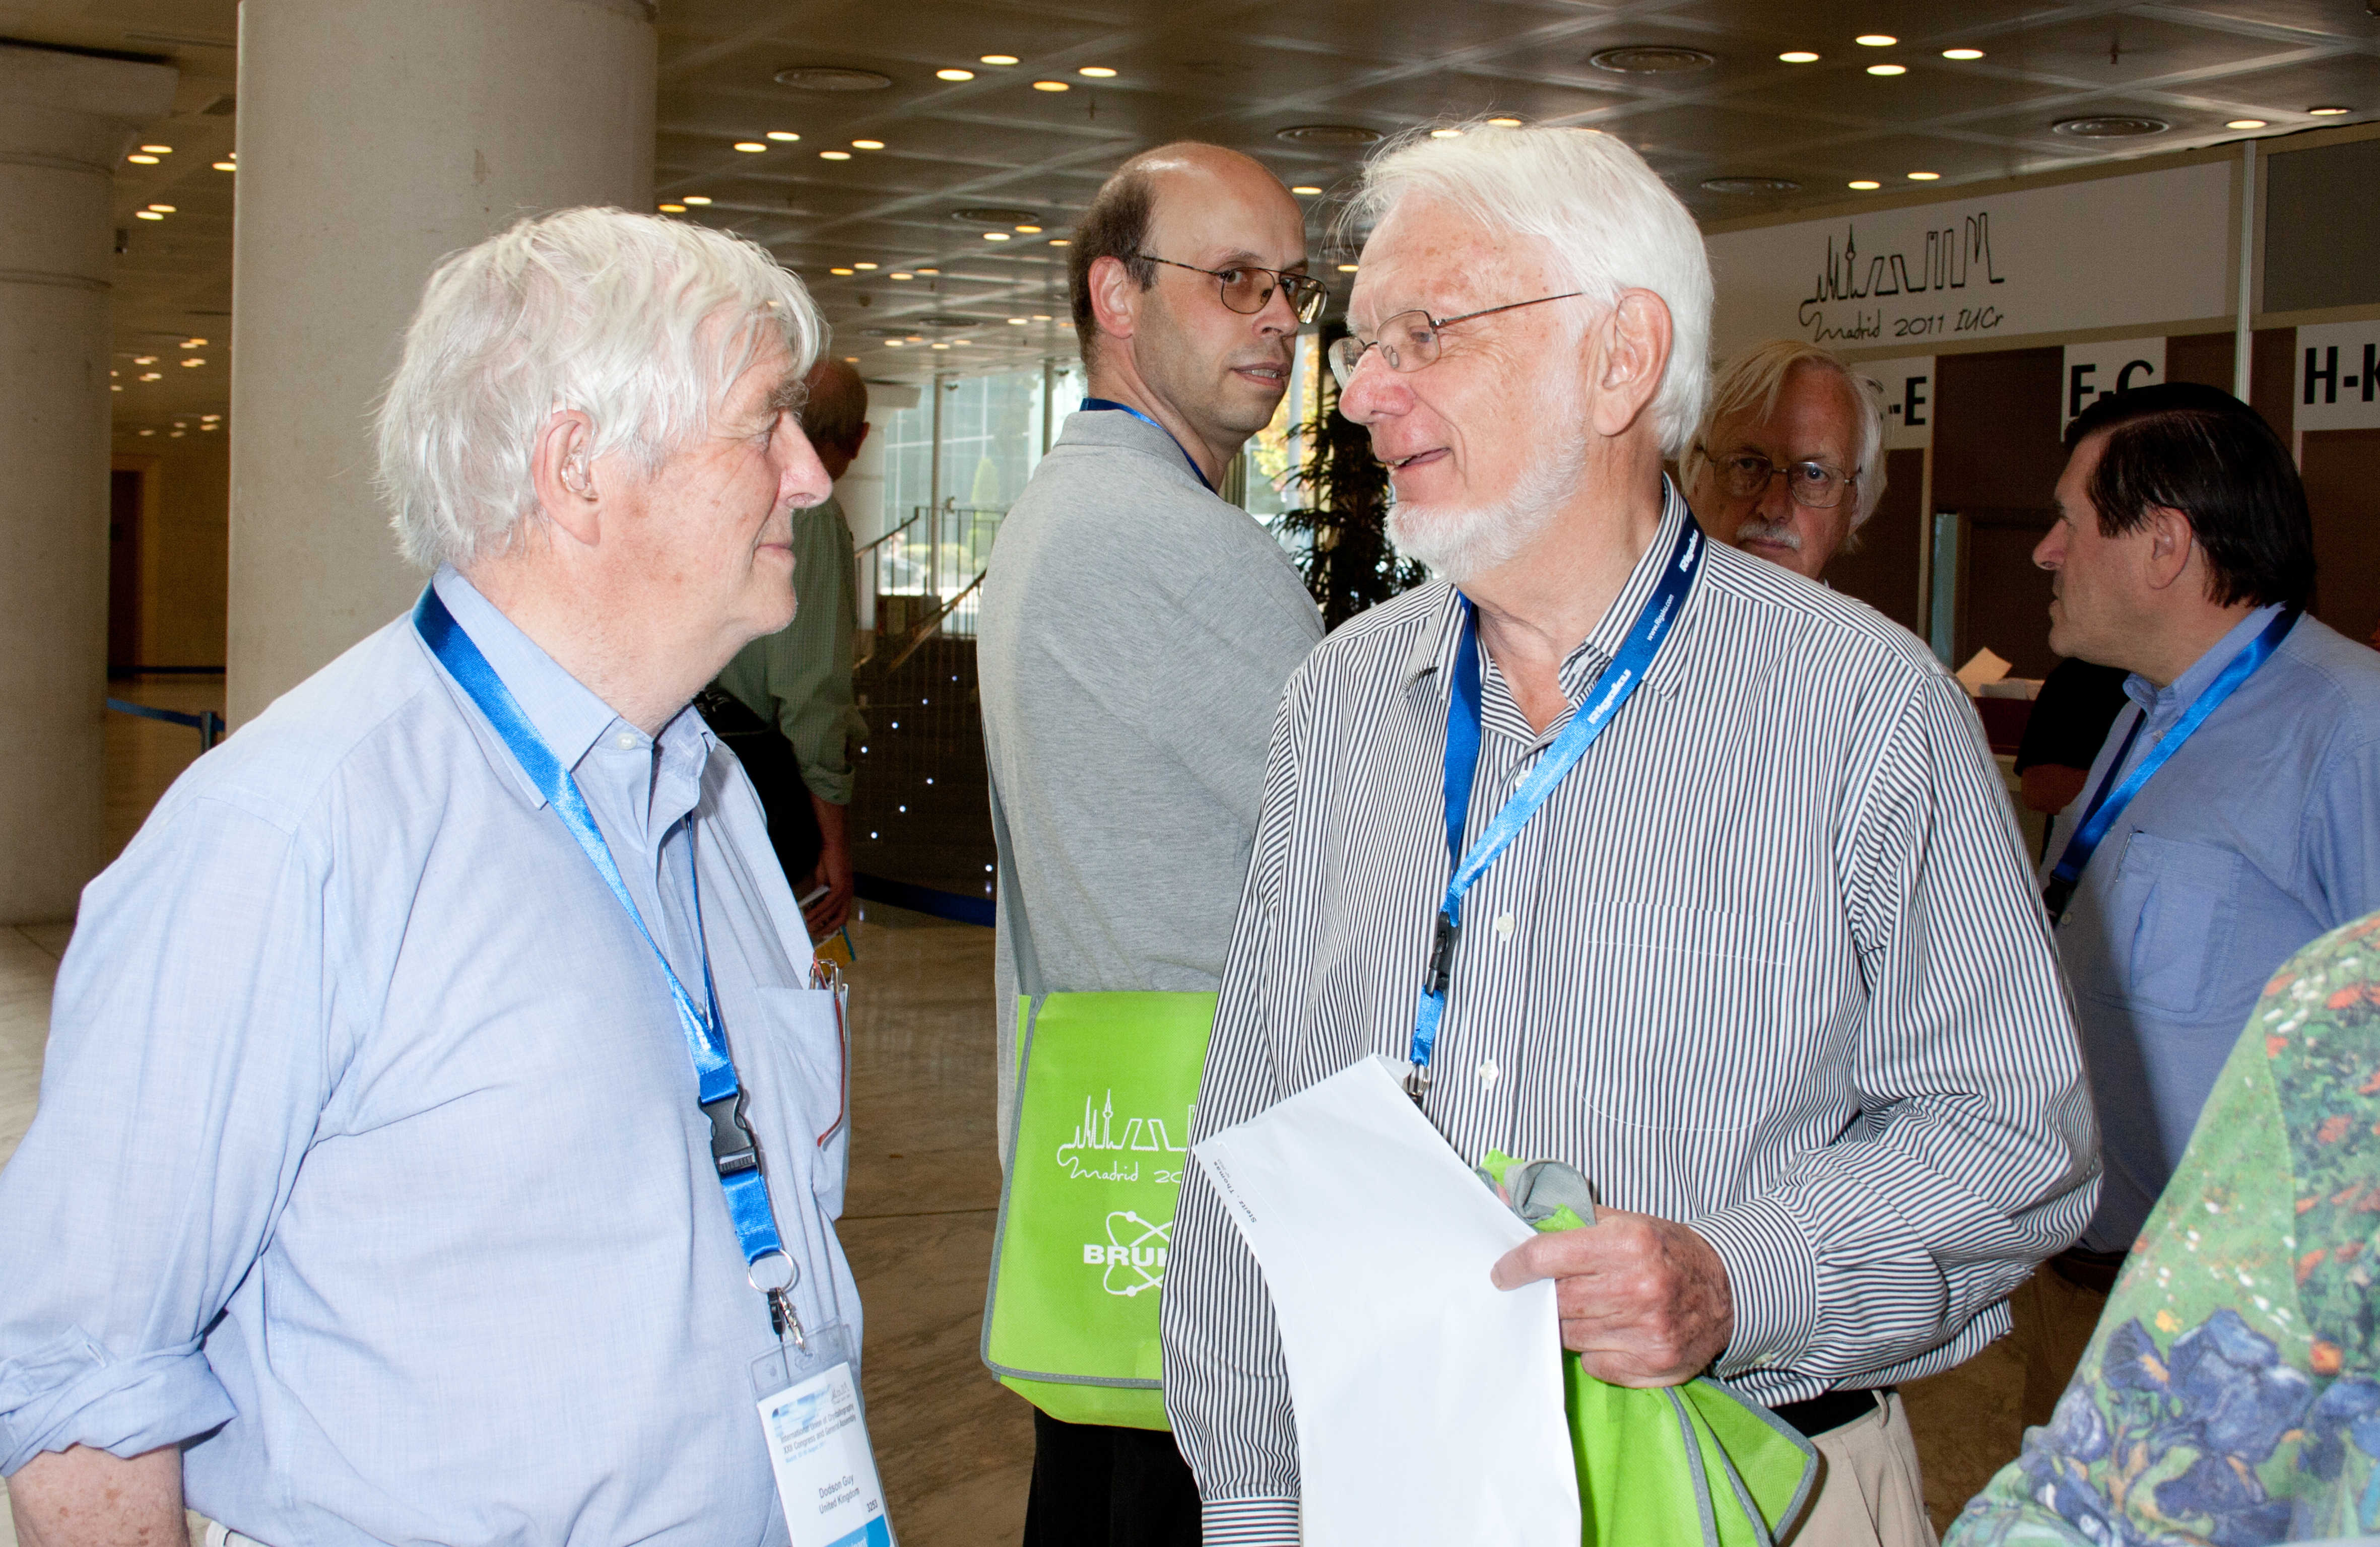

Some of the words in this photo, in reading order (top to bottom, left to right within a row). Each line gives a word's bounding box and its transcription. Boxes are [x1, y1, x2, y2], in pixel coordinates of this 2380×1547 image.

[1810, 308, 1881, 343] Madrid
[1893, 314, 1944, 337] 2011
[1866, 376, 1927, 426] -E
[1679, 529, 1699, 572] Rigaku
[1647, 594, 1675, 641] www.Rigaku.com
[1588, 669, 1632, 725] Rigaku
[1068, 1156, 1139, 1182] Madrid
[1213, 1161, 1235, 1194] Thomas
[819, 1481, 842, 1499] Dodson
[842, 1474, 853, 1487] Guy
[819, 1497, 837, 1514] United
[837, 1488, 860, 1505] Kingdom
